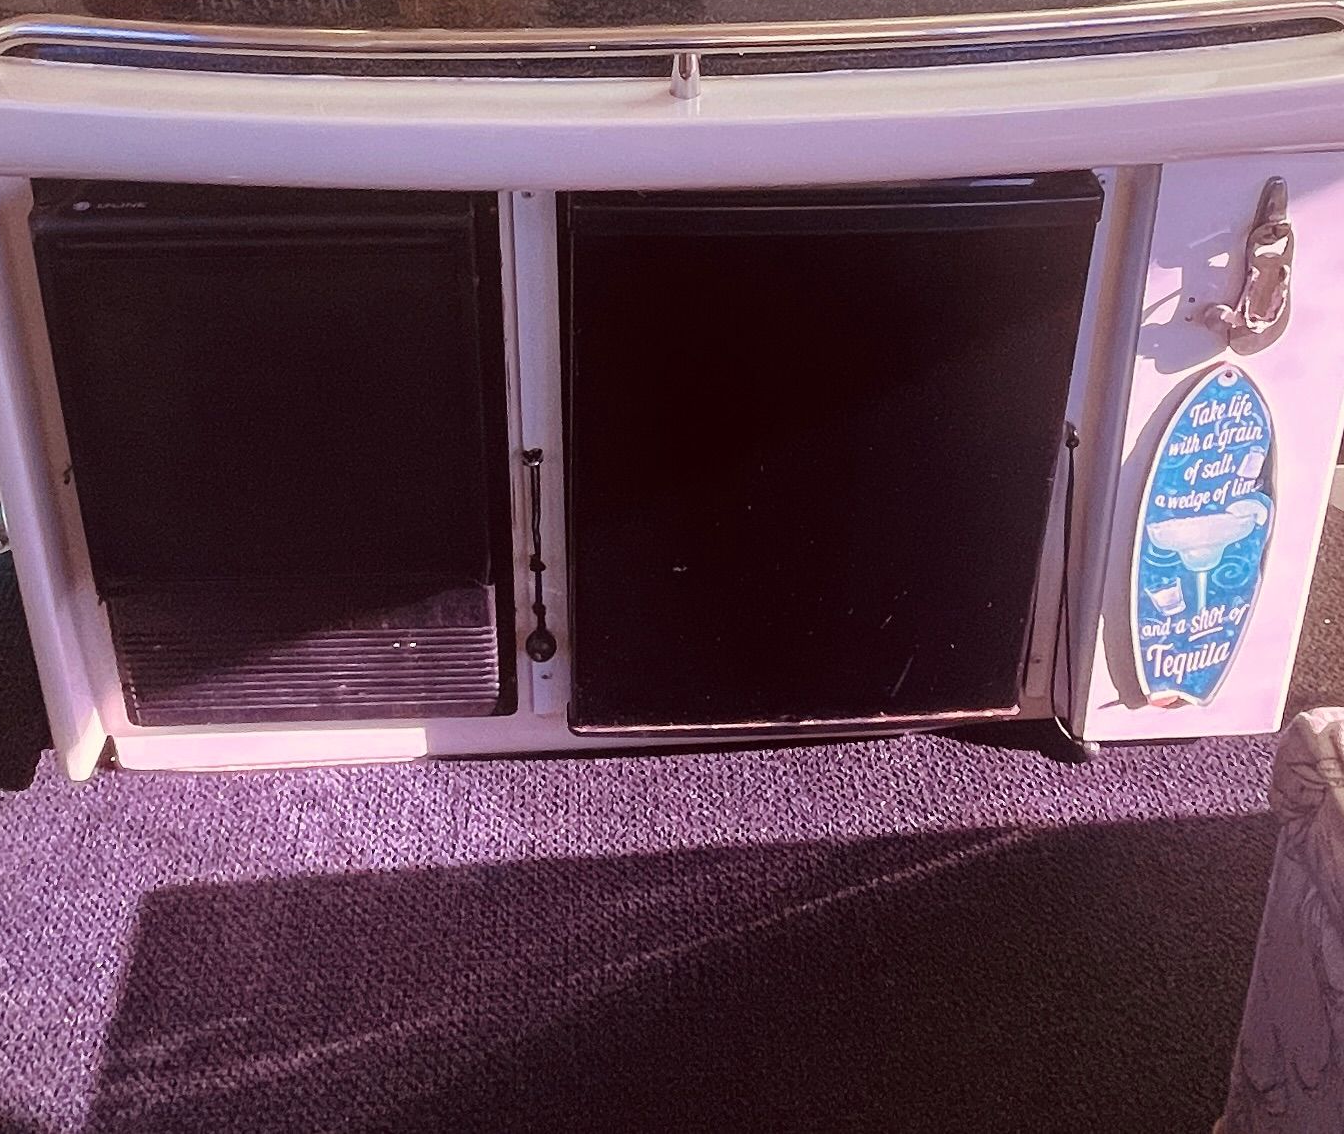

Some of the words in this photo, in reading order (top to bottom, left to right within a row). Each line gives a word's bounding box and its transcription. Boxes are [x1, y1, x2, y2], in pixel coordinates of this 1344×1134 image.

[1190, 399, 1226, 428] Take
[1228, 393, 1253, 423] life
[1168, 433, 1201, 456] with
[1202, 433, 1214, 451] a
[1218, 421, 1263, 453] grain
[1184, 459, 1203, 485] of
[1201, 453, 1236, 479] salt,
[1155, 495, 1167, 507] a
[1168, 490, 1211, 512] wedge
[1212, 481, 1231, 505] of
[1142, 616, 1172, 636] and
[1175, 619, 1187, 634] a
[1190, 604, 1226, 634] shot
[1228, 603, 1250, 625] of
[1146, 641, 1231, 684] Tequila
